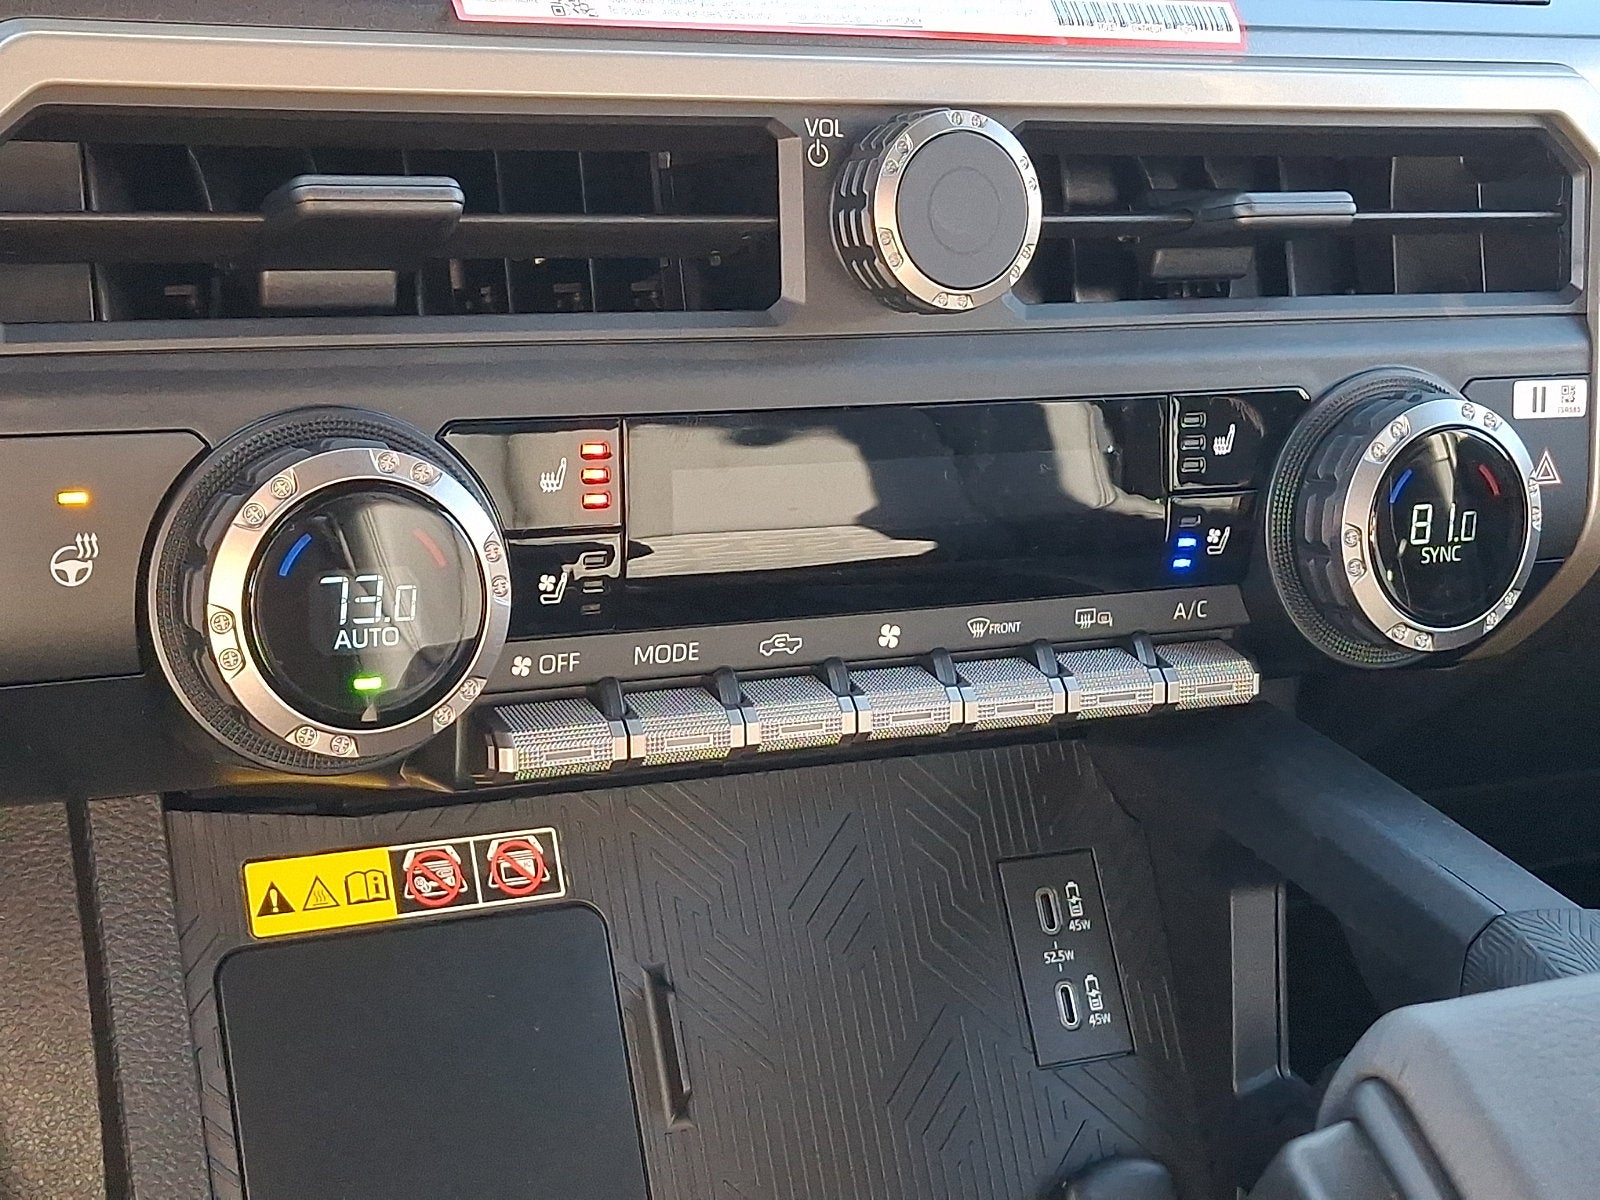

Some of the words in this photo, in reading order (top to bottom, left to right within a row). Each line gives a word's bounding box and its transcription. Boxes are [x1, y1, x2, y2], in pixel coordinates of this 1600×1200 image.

[804, 118, 844, 138] VOL
[1410, 503, 1477, 545] 81.0
[1420, 545, 1462, 564] SYNC
[320, 574, 417, 626] 73.0
[1173, 600, 1208, 621] A/C
[333, 626, 400, 650] AUTO
[988, 621, 1022, 635] FRONT
[538, 652, 581, 675] OFF
[633, 641, 700, 666] MODE
[1068, 918, 1091, 932] 45W
[1088, 1012, 1111, 1027] 45W
